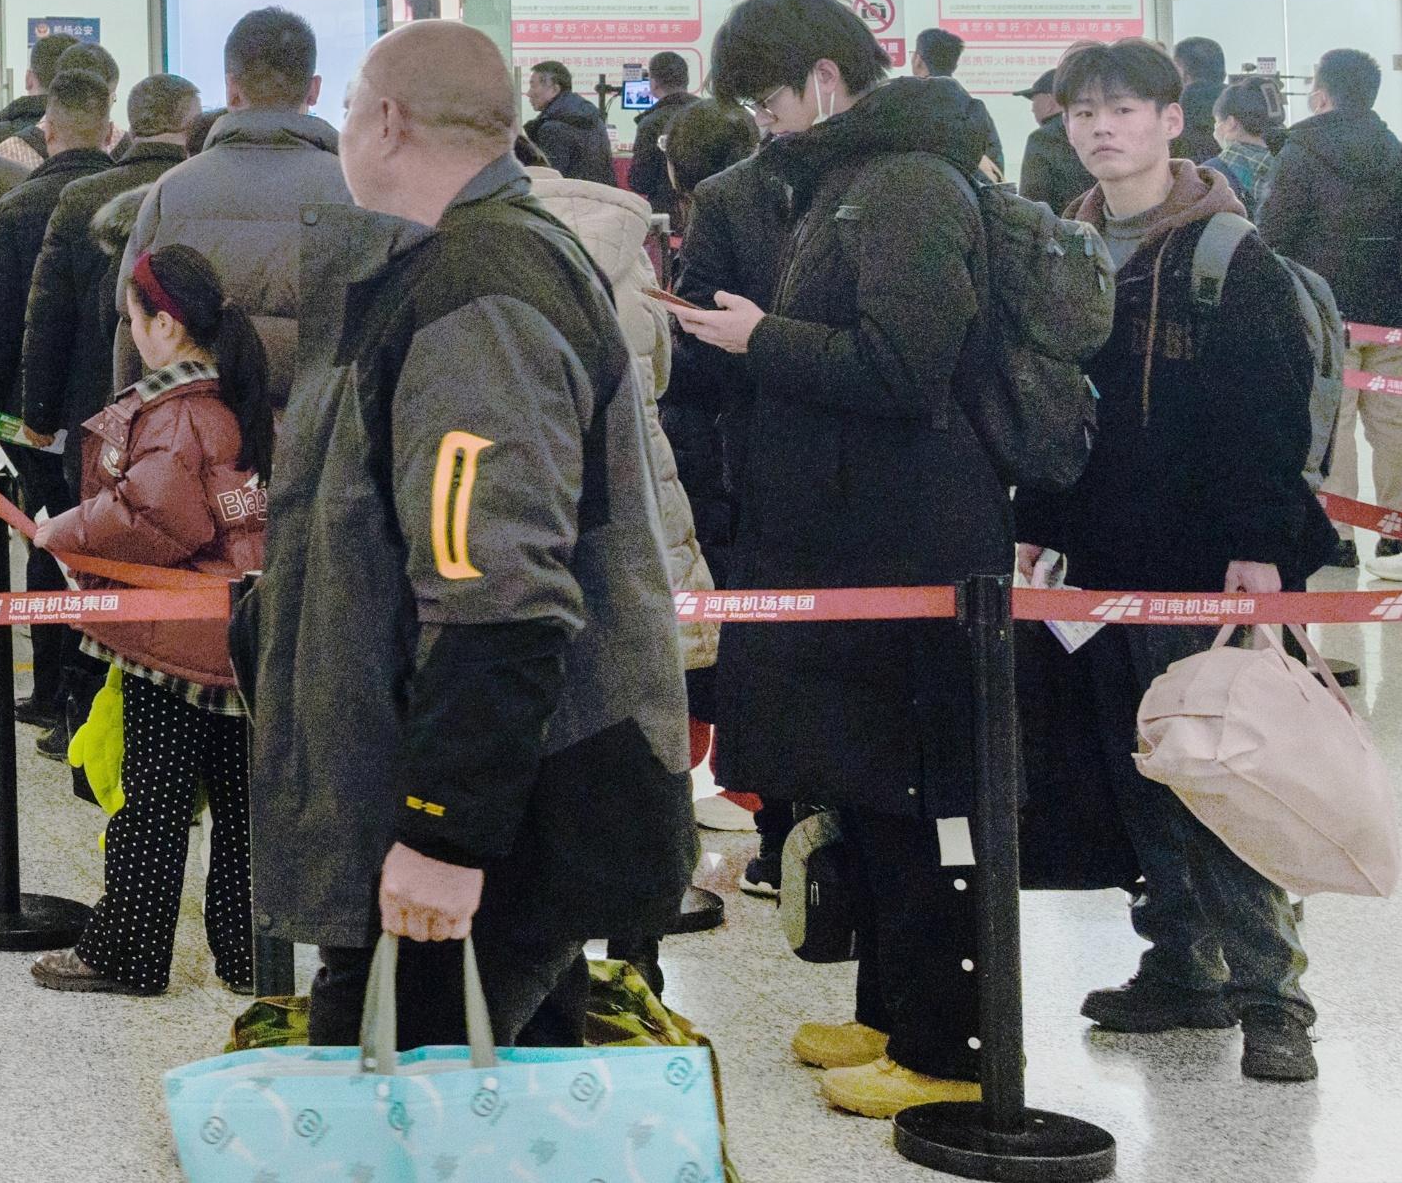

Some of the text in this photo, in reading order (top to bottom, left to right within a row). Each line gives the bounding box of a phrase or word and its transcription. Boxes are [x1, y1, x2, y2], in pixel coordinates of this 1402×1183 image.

[9, 595, 119, 613] 河南机场集团
[704, 595, 815, 612] 河南机场集团
[1149, 599, 1255, 614] 河南机场集团
